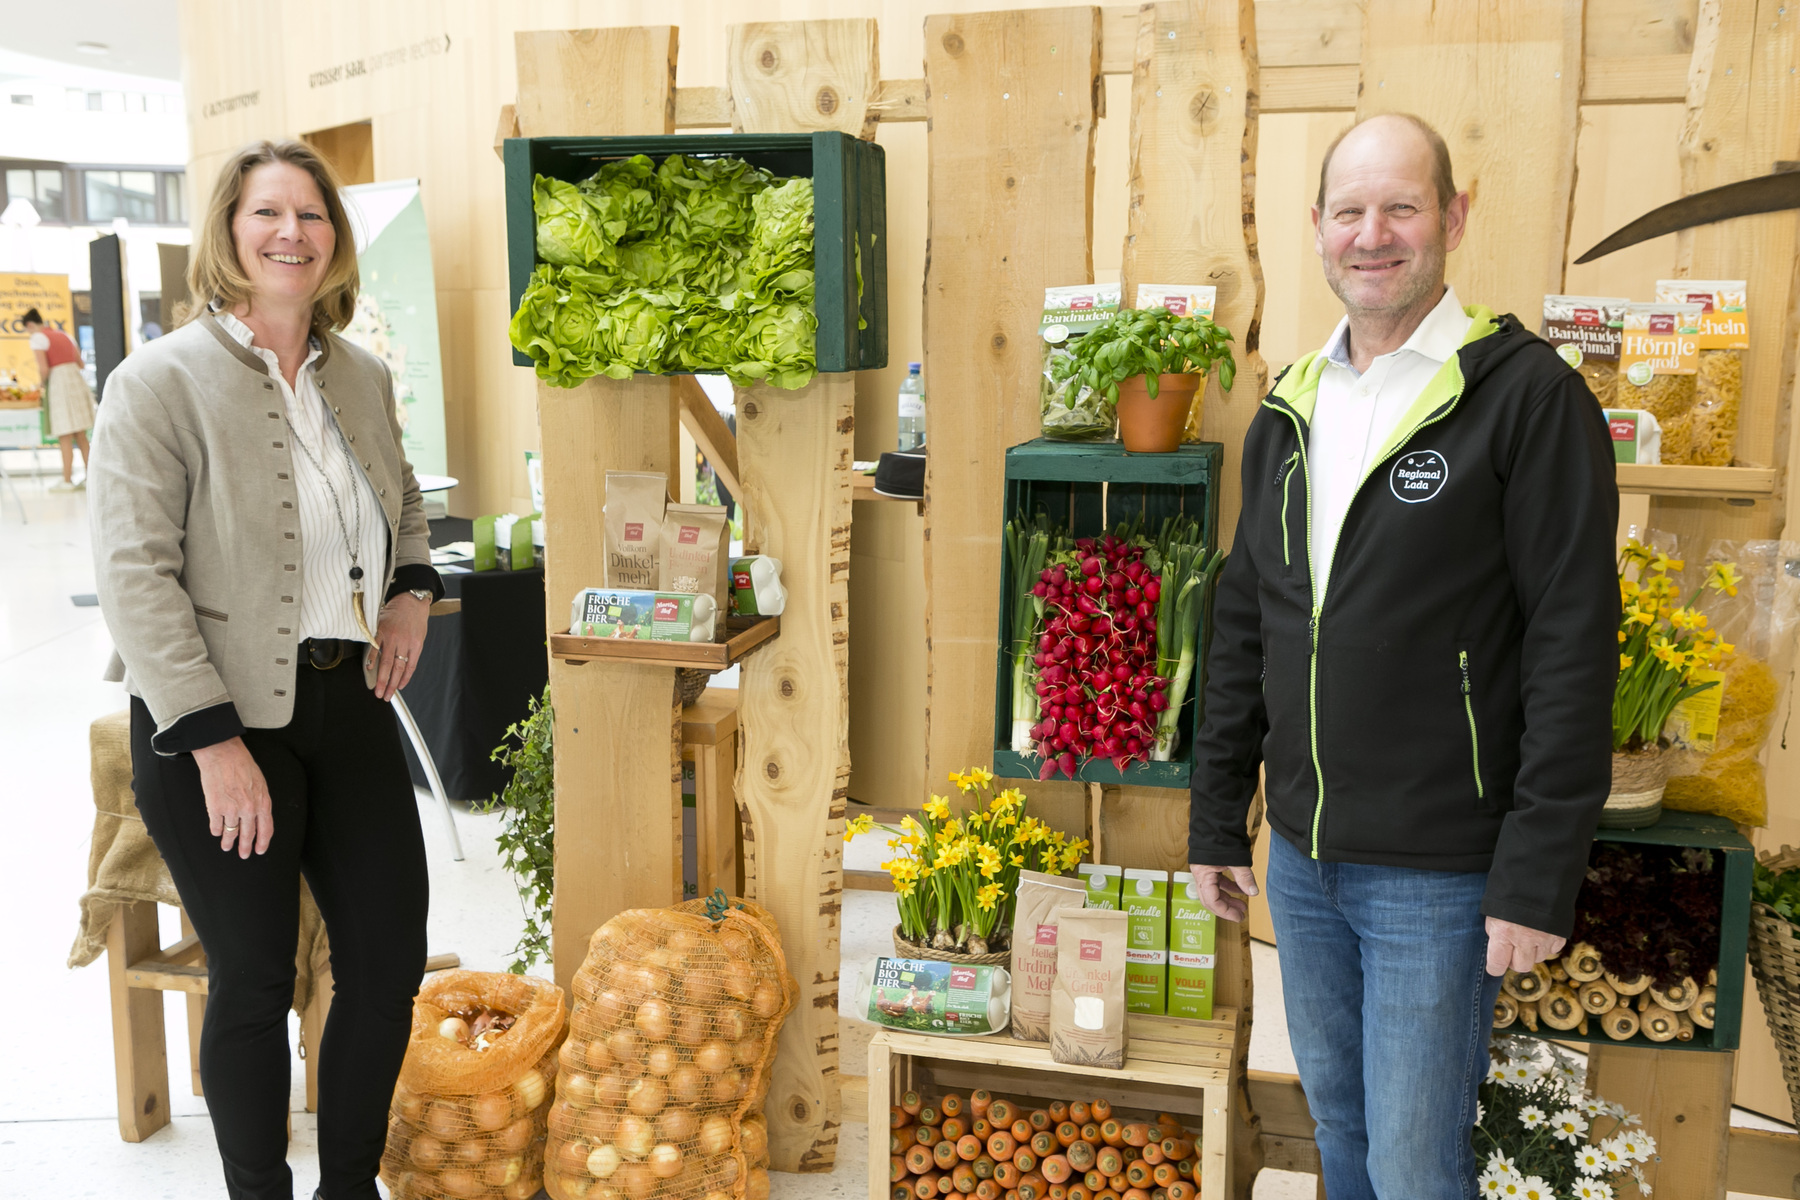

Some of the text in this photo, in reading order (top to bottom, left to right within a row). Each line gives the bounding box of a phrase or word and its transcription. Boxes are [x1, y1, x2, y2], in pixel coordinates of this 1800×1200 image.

[1042, 311, 1114, 324] Bandnudeln
[1548, 326, 1623, 343] Bandnudel
[1572, 341, 1615, 355] chmal
[1626, 336, 1696, 356] Hörnle
[1646, 355, 1680, 369] groß
[1398, 469, 1441, 480] Regional
[1404, 480, 1429, 489] Lada
[611, 552, 660, 570] Dinkel-
[669, 547, 710, 563] Udinkel
[618, 570, 650, 585] mehl
[588, 594, 631, 606] FRISCHE
[587, 604, 606, 614] BIO
[586, 613, 608, 624] EIER
[1086, 900, 1114, 910] ändle
[1128, 904, 1161, 918] Ländle
[1174, 908, 1211, 921] Ländle
[1032, 948, 1058, 958] Helles
[880, 960, 925, 972] FRISCHE
[878, 969, 898, 979] BIO
[1065, 967, 1112, 981] Urnkel
[1128, 974, 1158, 984] VOLLEI
[876, 978, 900, 988] EIER
[1071, 980, 1104, 994] Grieß
[1175, 977, 1206, 989] VOLLEI
